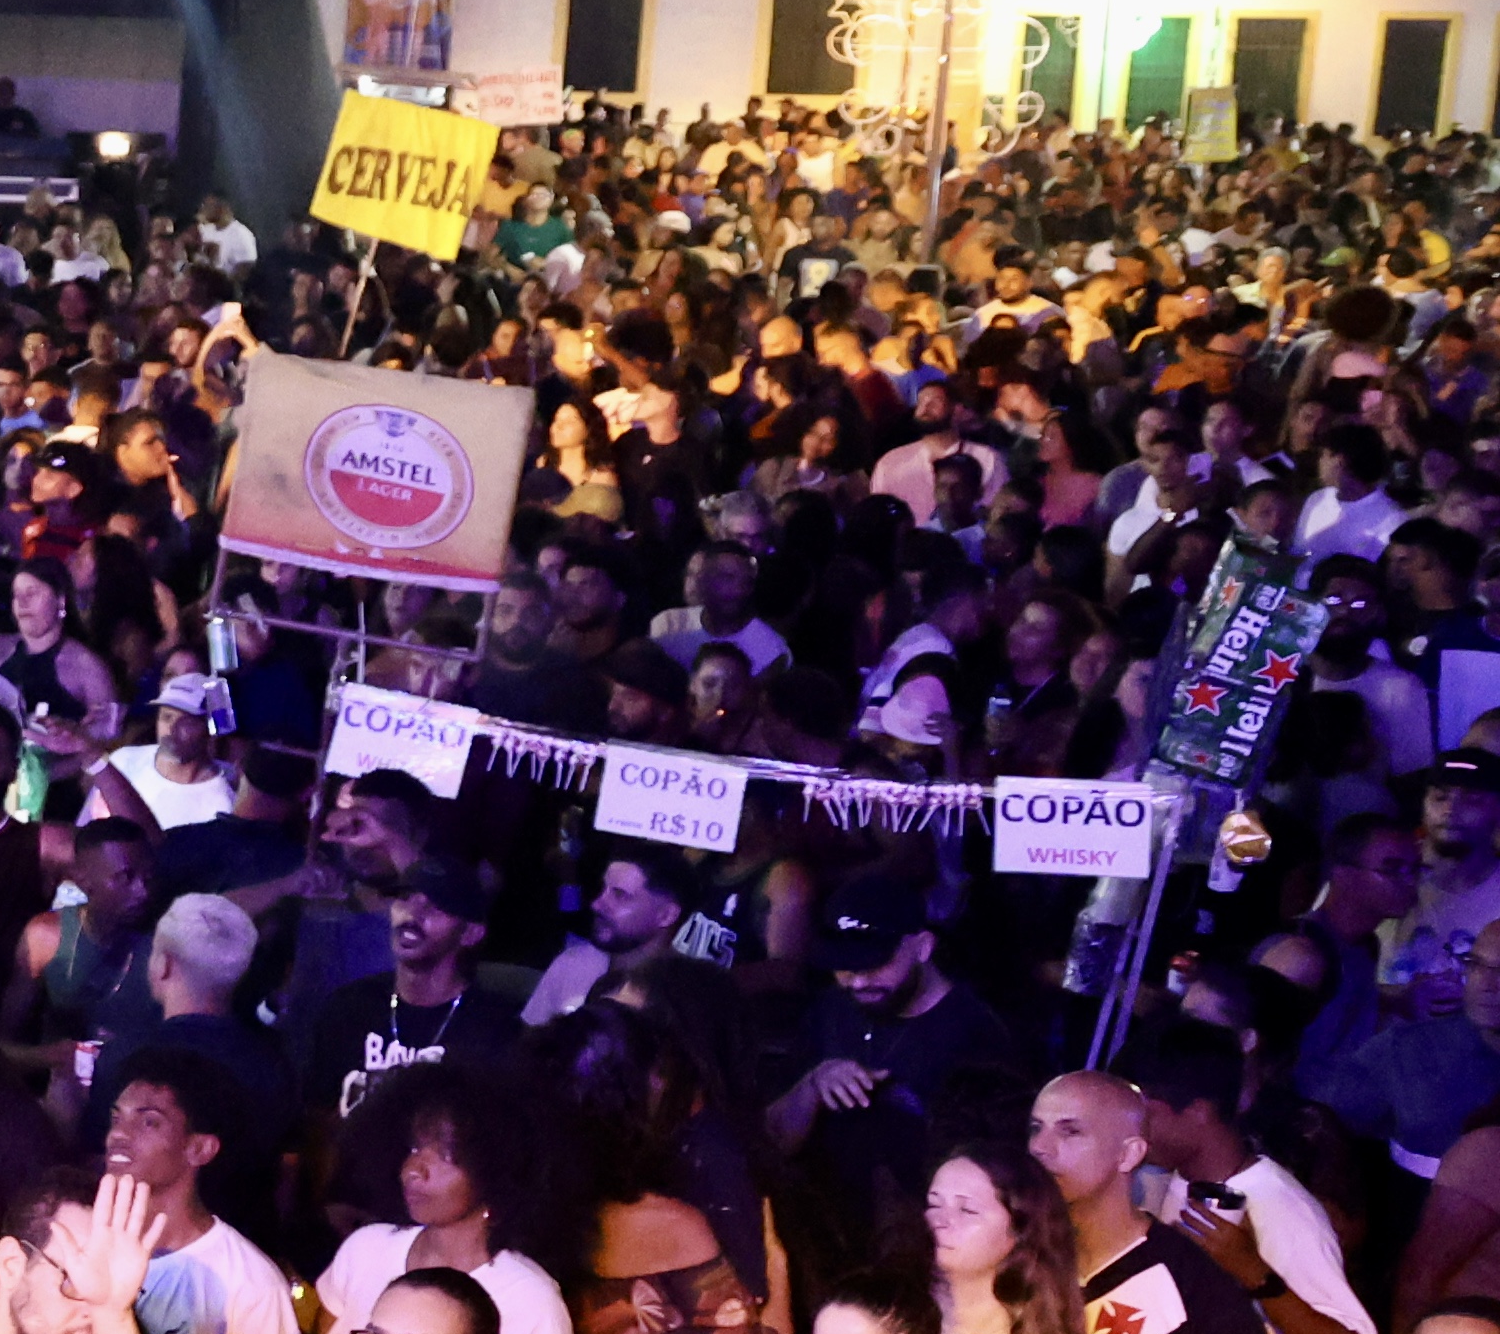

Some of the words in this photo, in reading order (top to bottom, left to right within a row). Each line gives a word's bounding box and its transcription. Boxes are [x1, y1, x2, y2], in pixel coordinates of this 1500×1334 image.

[327, 144, 473, 218] CERVEJA
[341, 449, 437, 486] AMSTEL
[355, 478, 414, 501] LAGER
[620, 763, 729, 801] COPÃO
[1001, 790, 1146, 827] COPÃO
[649, 811, 724, 844] R$10
[1027, 847, 1118, 867] WHISKY
